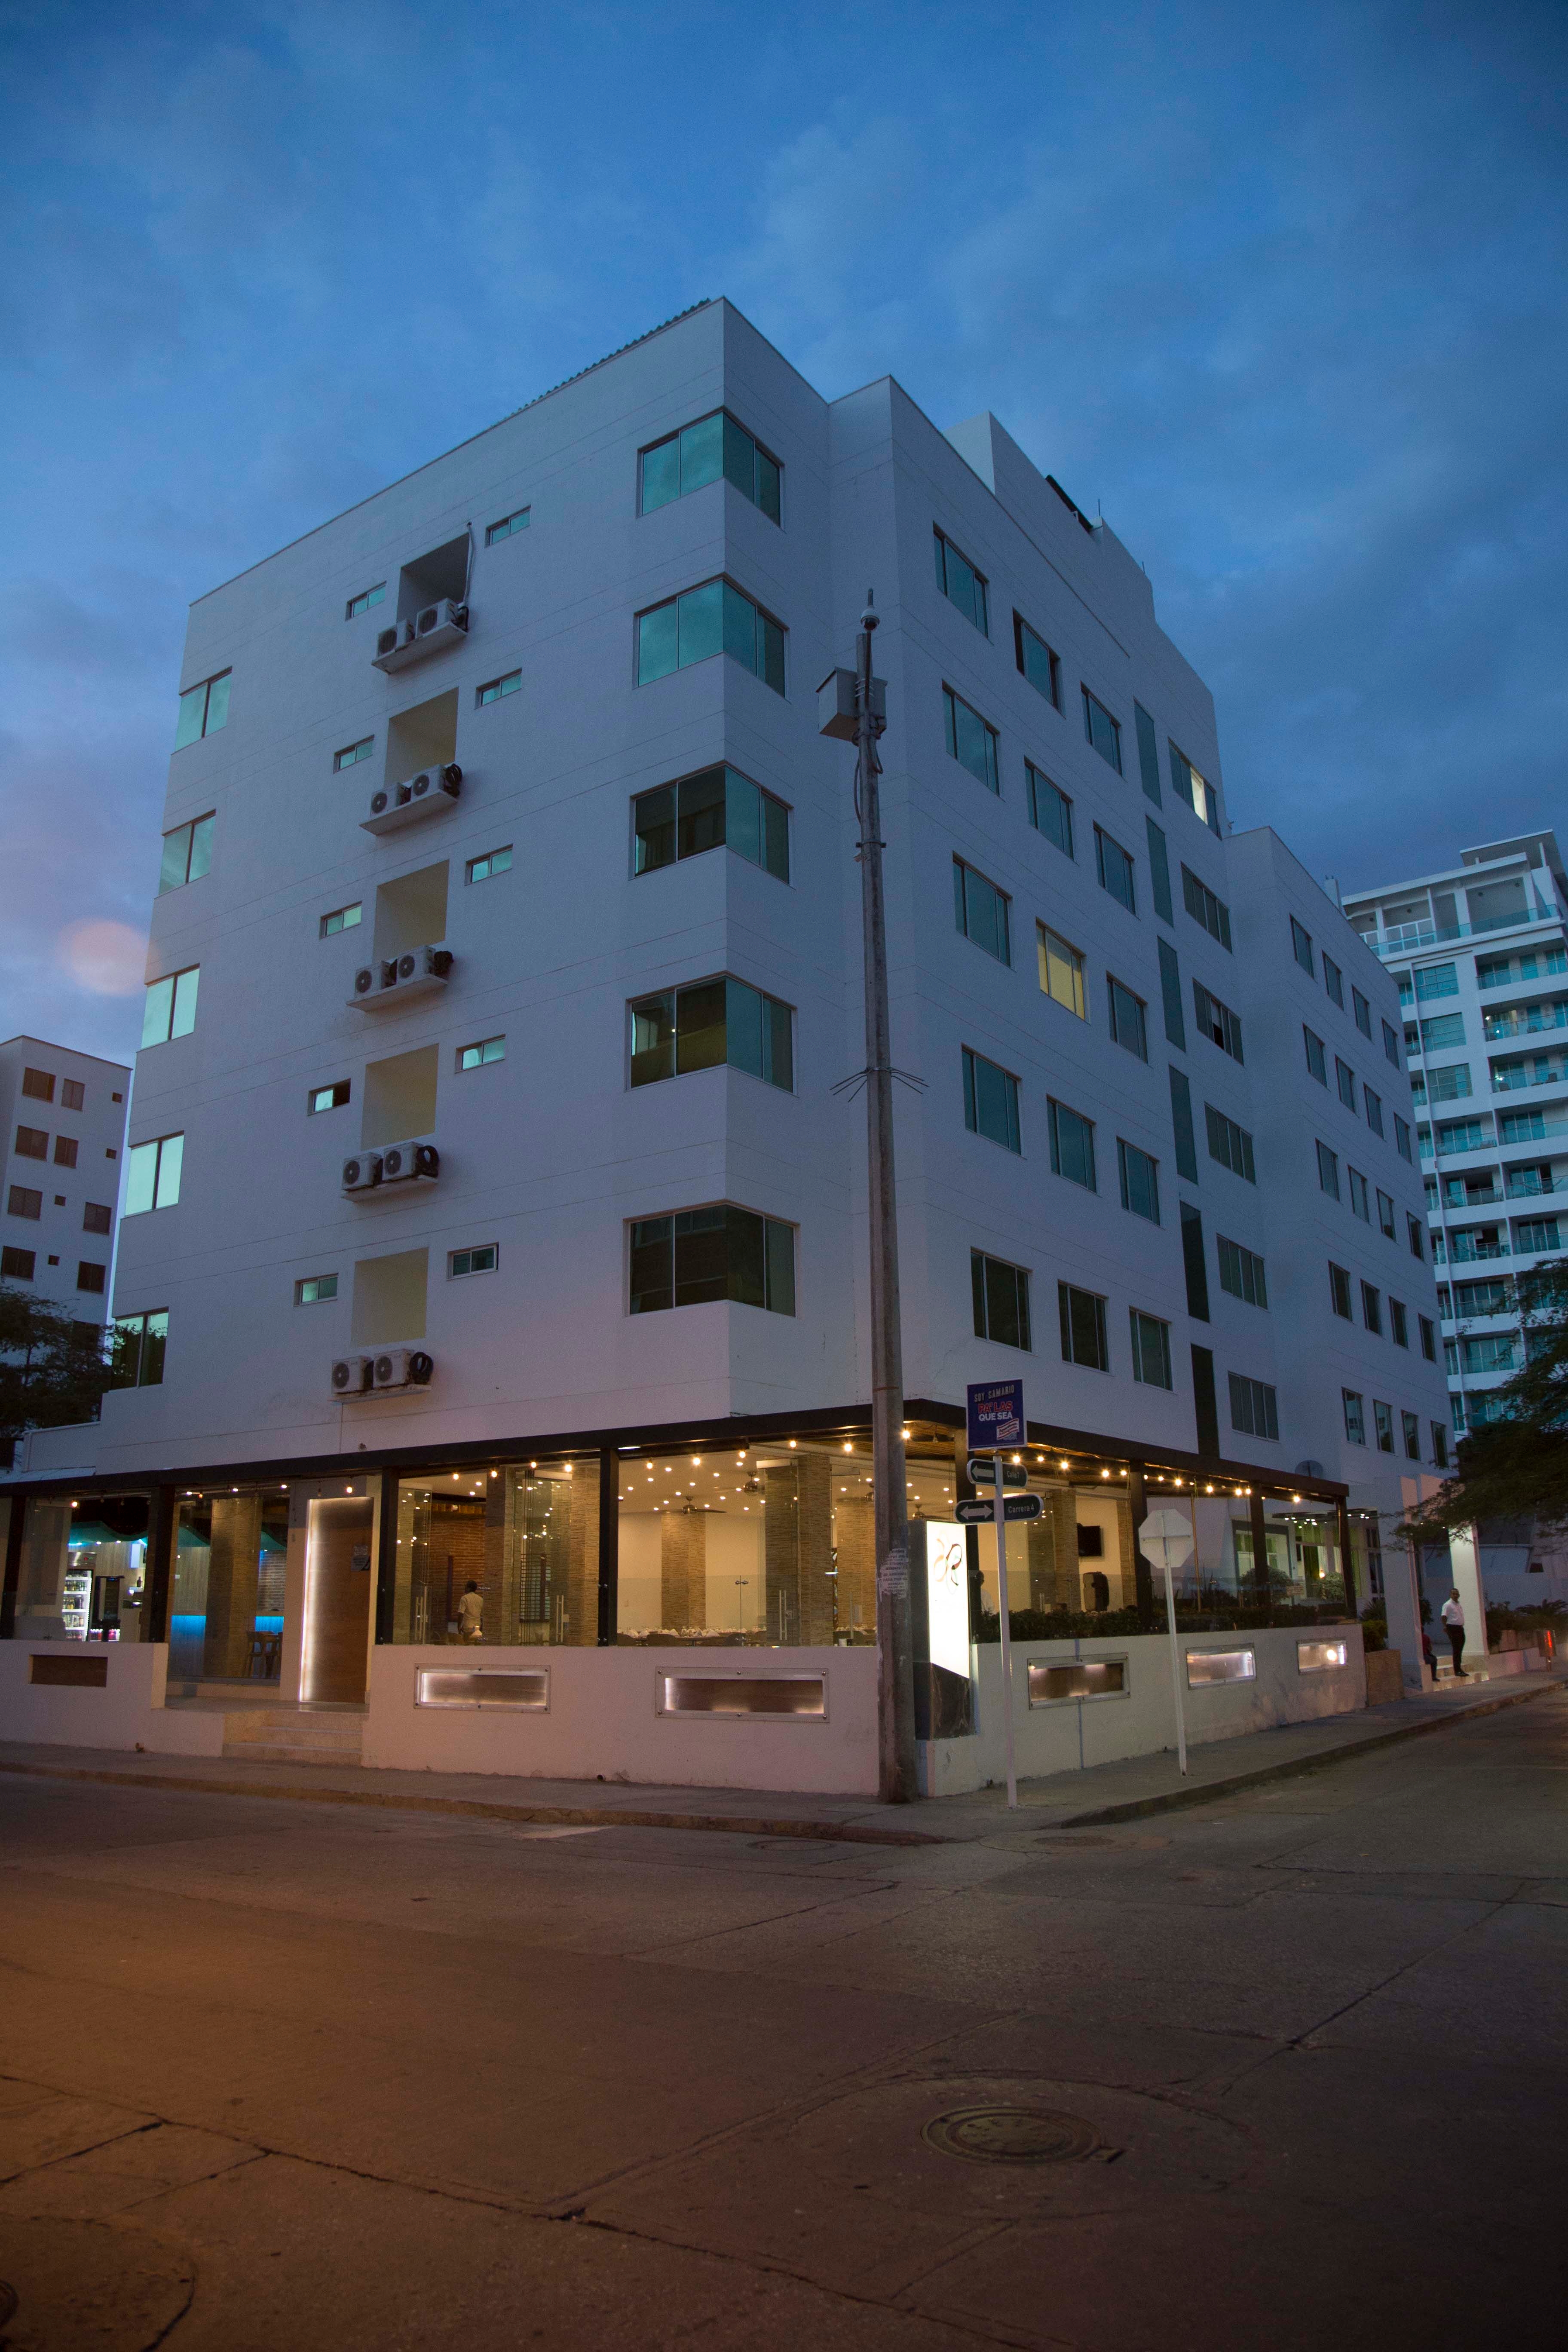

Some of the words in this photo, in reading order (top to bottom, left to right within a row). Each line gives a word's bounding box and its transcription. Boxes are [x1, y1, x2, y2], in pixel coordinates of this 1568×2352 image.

[974, 1393, 985, 1402] SOY
[989, 1385, 1014, 1399] SAMARIO
[993, 1401, 1013, 1412] LAS
[979, 1412, 996, 1421] QUE
[997, 1411, 1013, 1420] SEA
